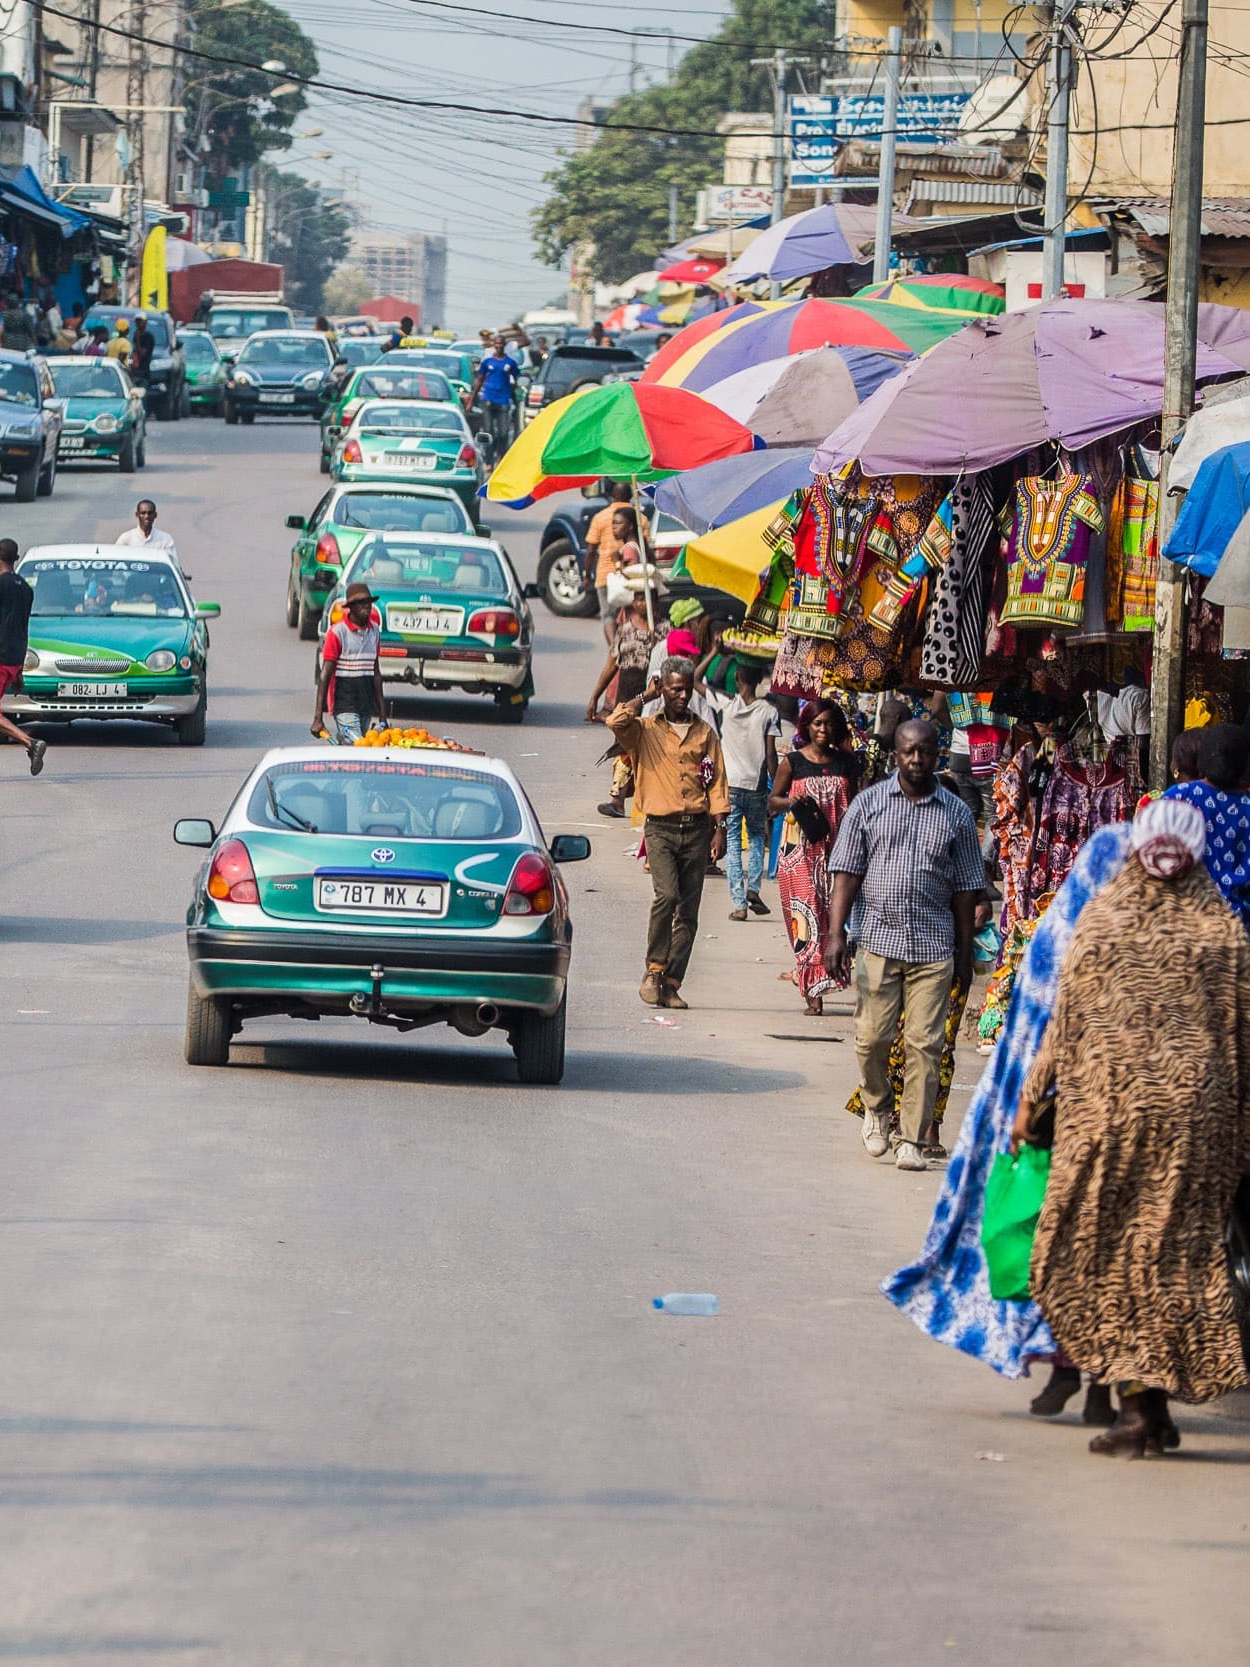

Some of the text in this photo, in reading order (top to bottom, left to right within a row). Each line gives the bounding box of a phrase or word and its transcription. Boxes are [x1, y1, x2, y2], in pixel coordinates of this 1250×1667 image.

[56, 560, 128, 571] TOYOTA
[444, 619, 451, 630] 4
[96, 684, 107, 696] LJ
[114, 684, 120, 695] 4
[273, 883, 299, 891] TOYOTA
[340, 884, 427, 907] 787 MX 4
